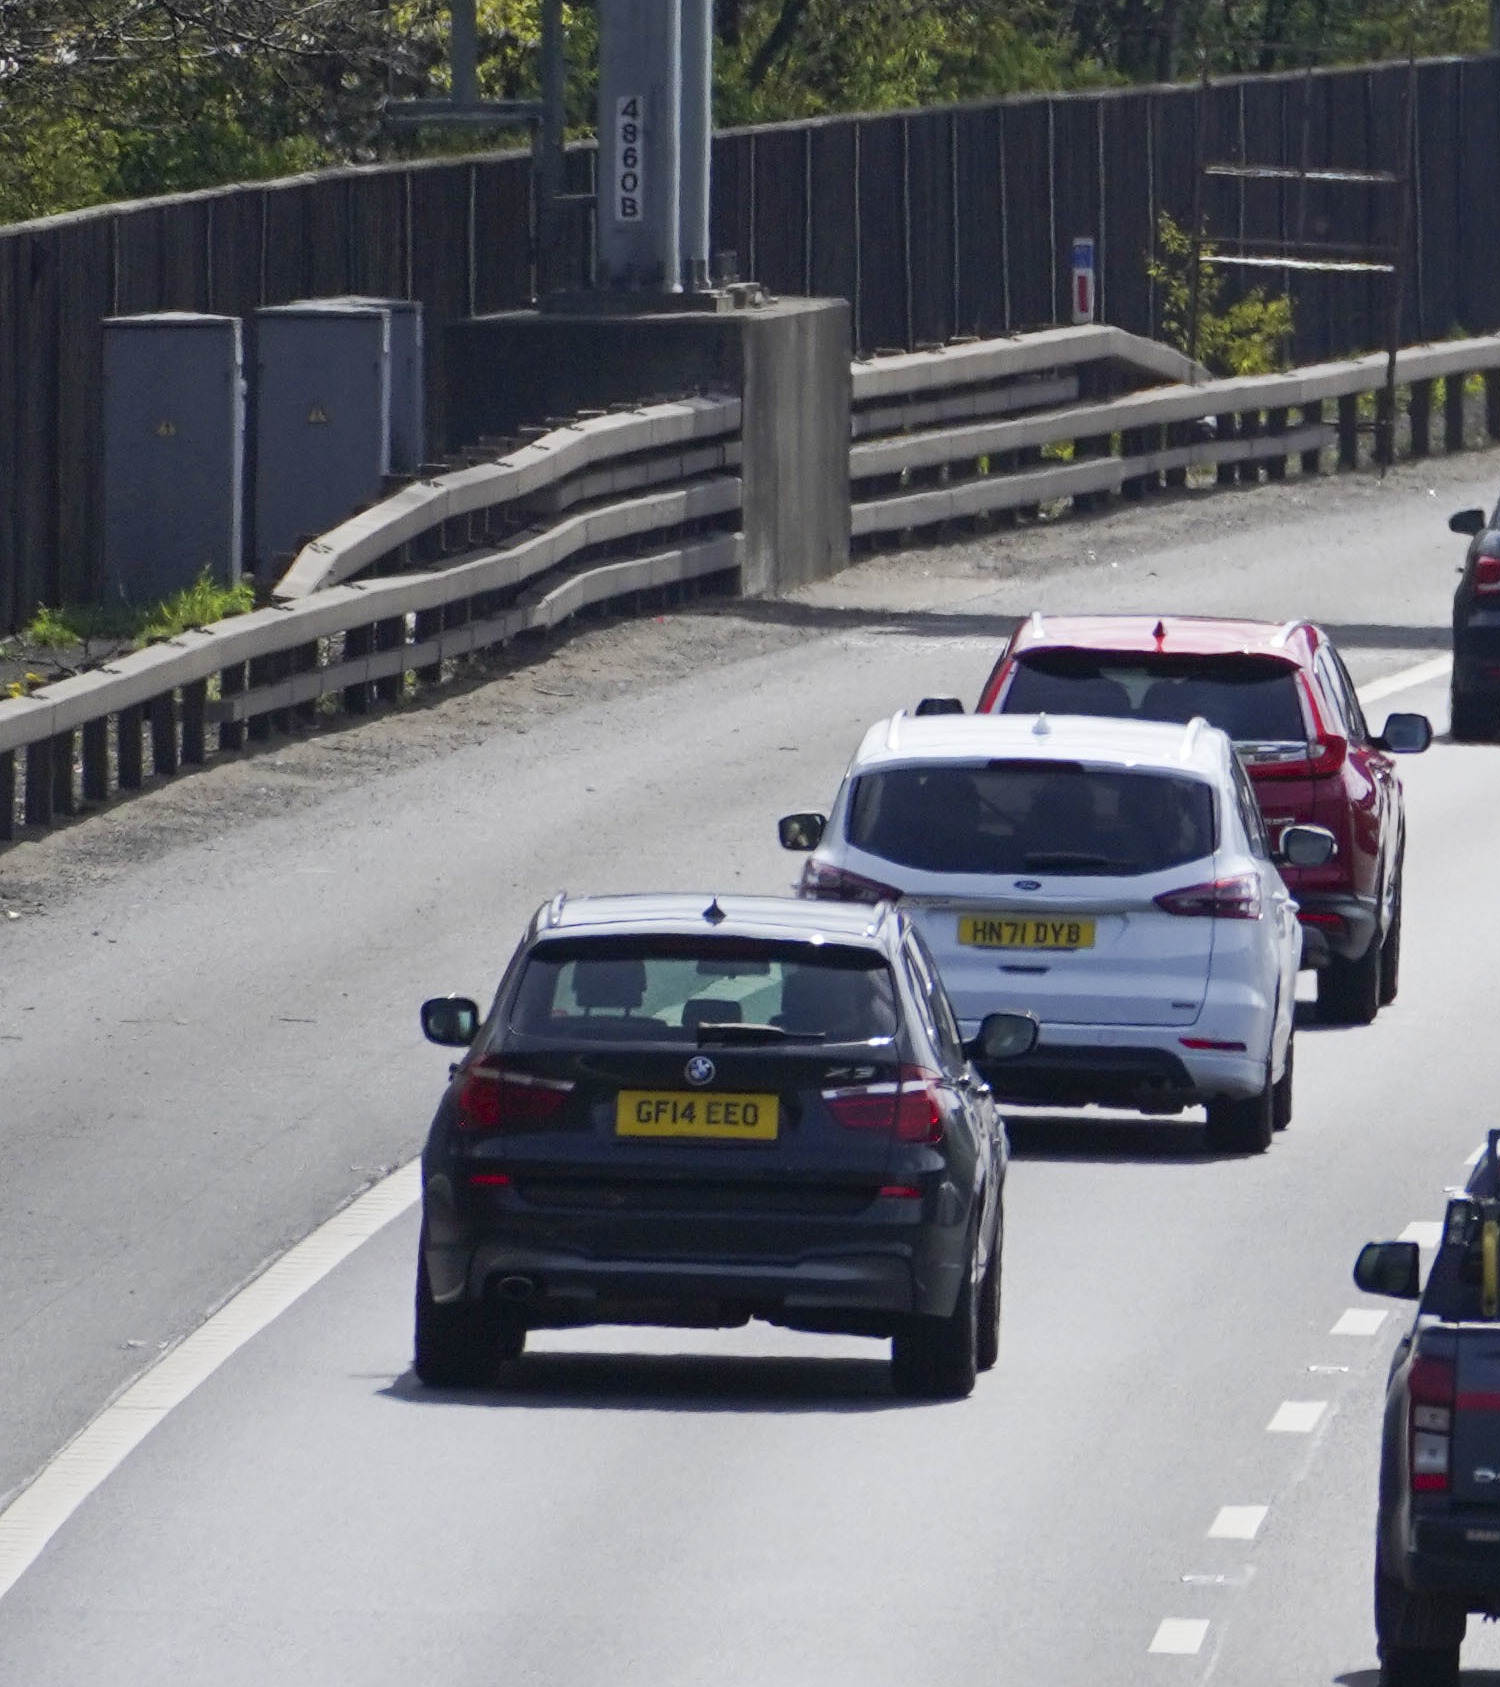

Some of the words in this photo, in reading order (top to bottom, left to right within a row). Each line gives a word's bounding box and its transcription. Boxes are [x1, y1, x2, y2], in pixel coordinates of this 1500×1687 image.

[619, 98, 639, 217] 4860B
[973, 921, 1026, 942] HN71
[1034, 923, 1080, 943] DYB
[637, 1099, 695, 1124] GF14
[706, 1101, 758, 1127] EEO
